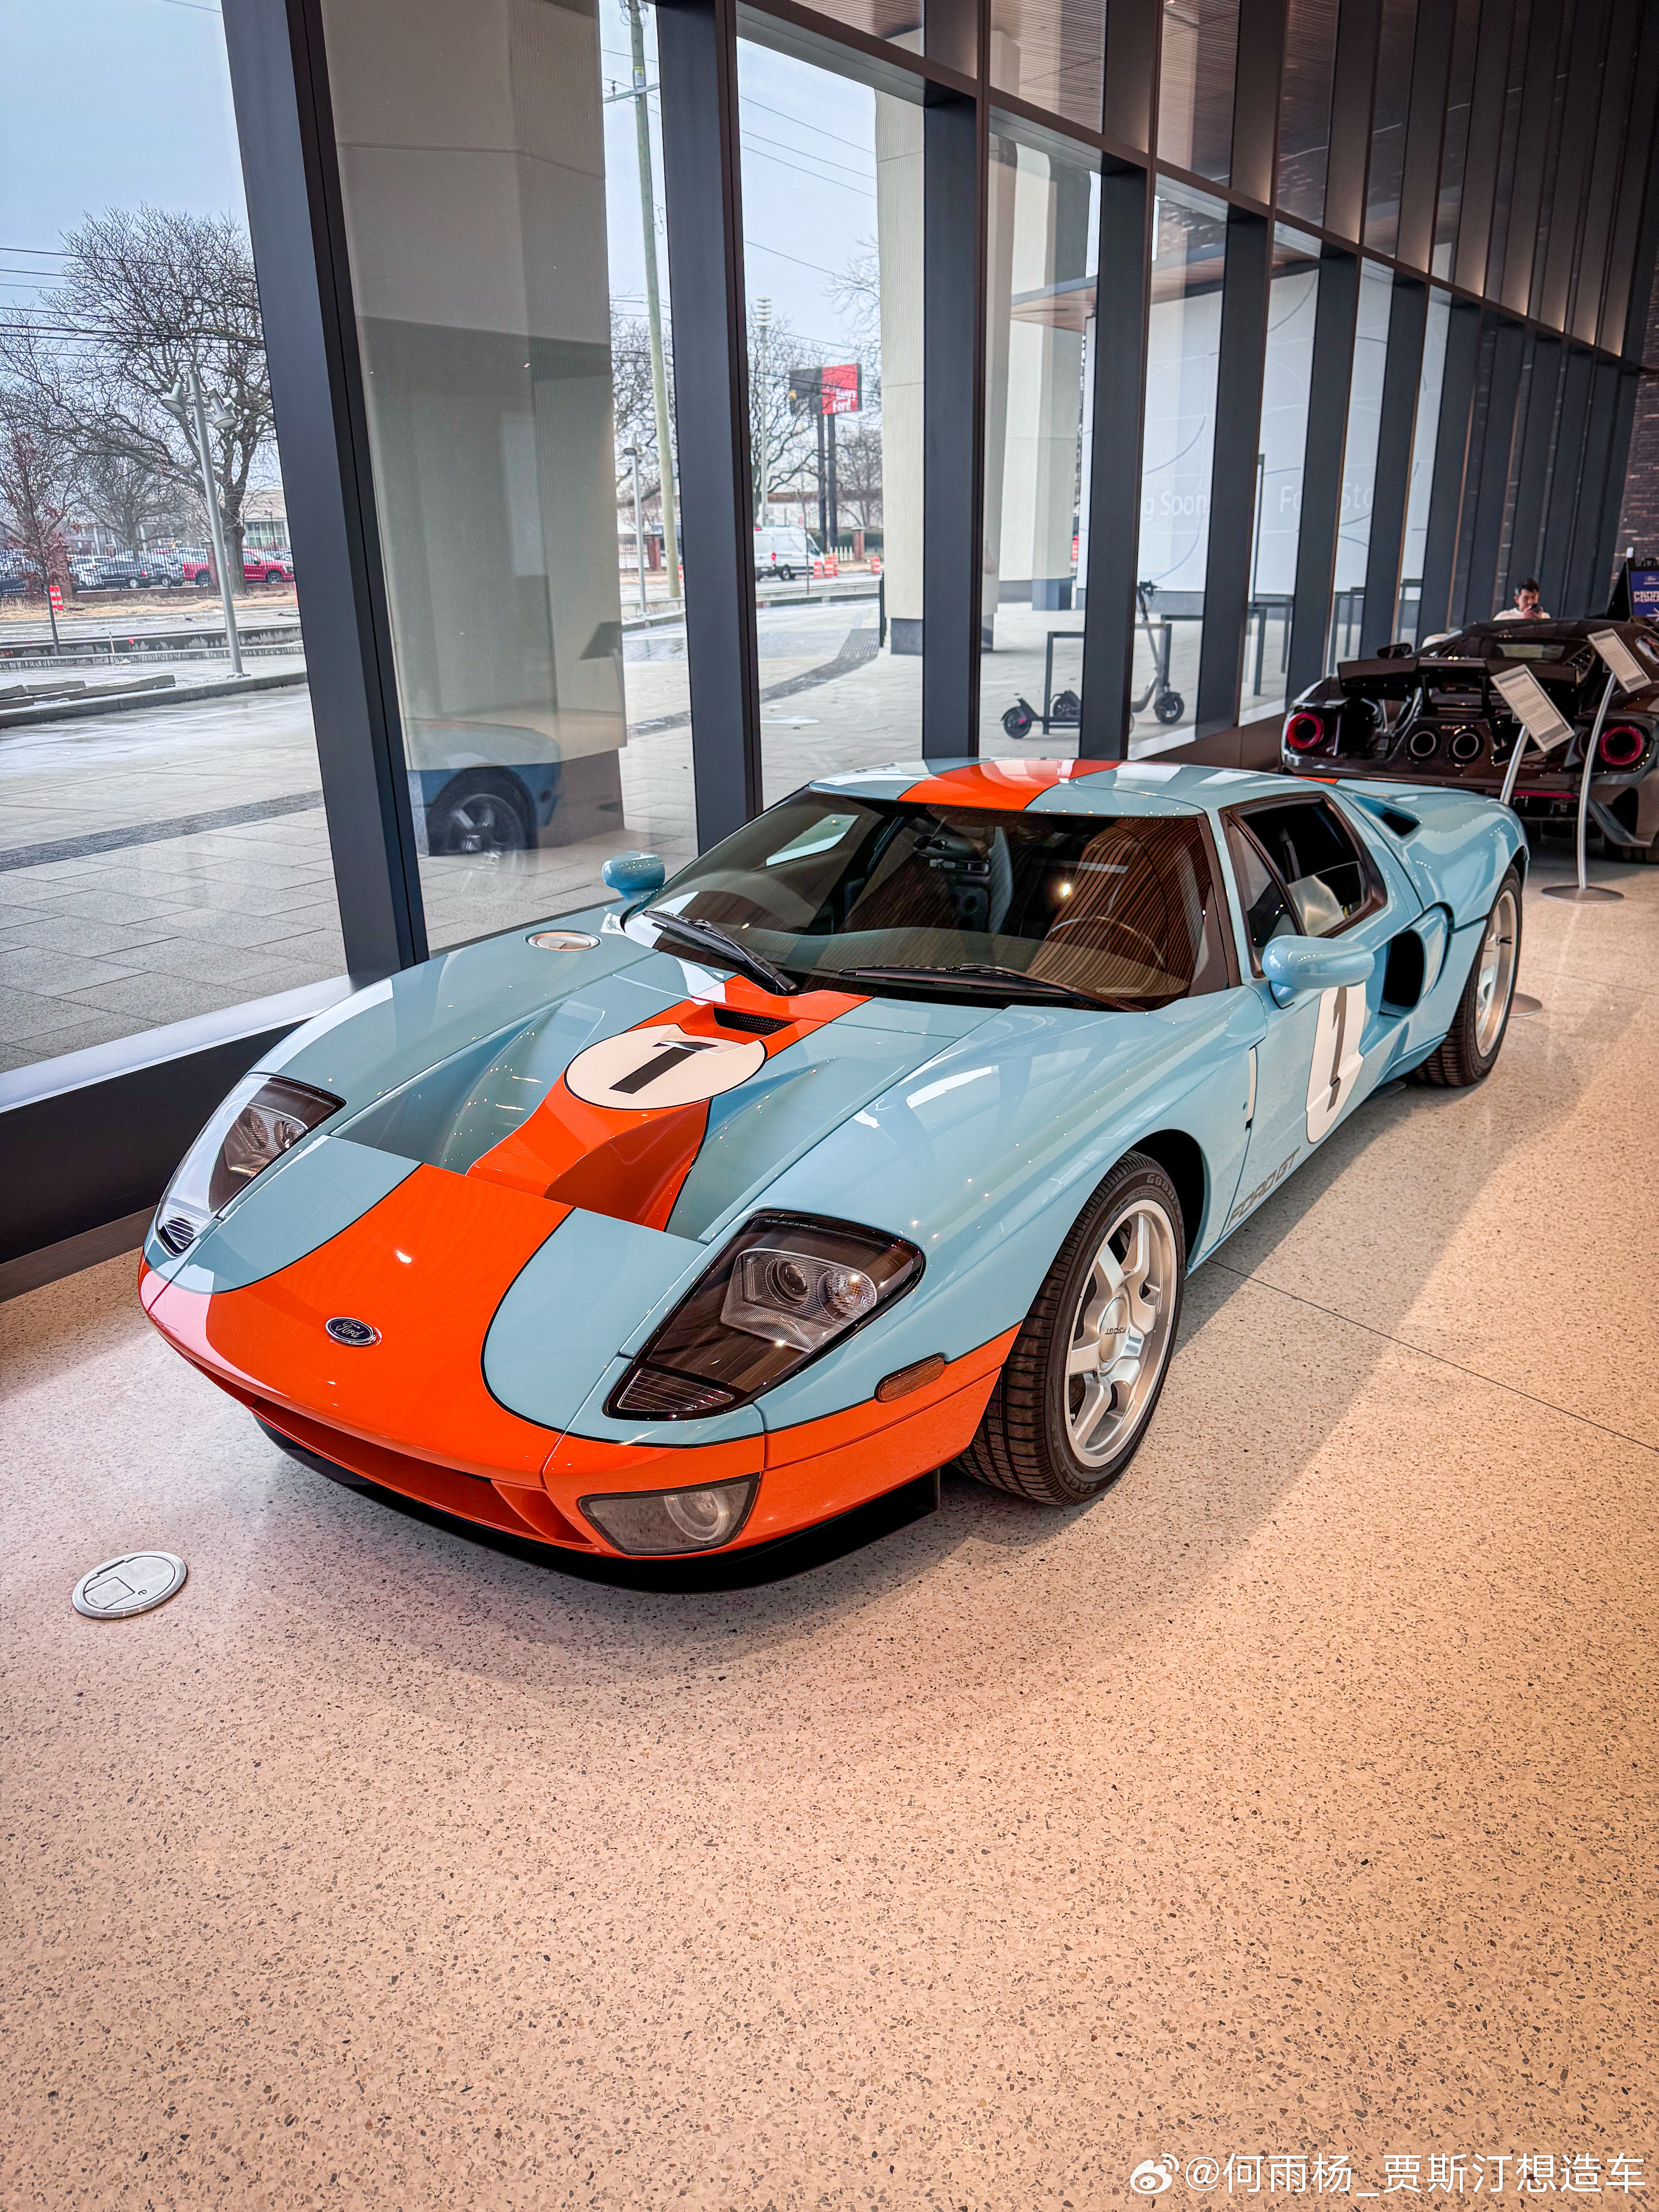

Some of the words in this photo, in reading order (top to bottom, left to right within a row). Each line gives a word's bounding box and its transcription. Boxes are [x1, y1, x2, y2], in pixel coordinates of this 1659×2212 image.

[1161, 491, 1206, 516] Soon
[608, 1041, 719, 1094] 1
[335, 1321, 364, 1338] Ford
